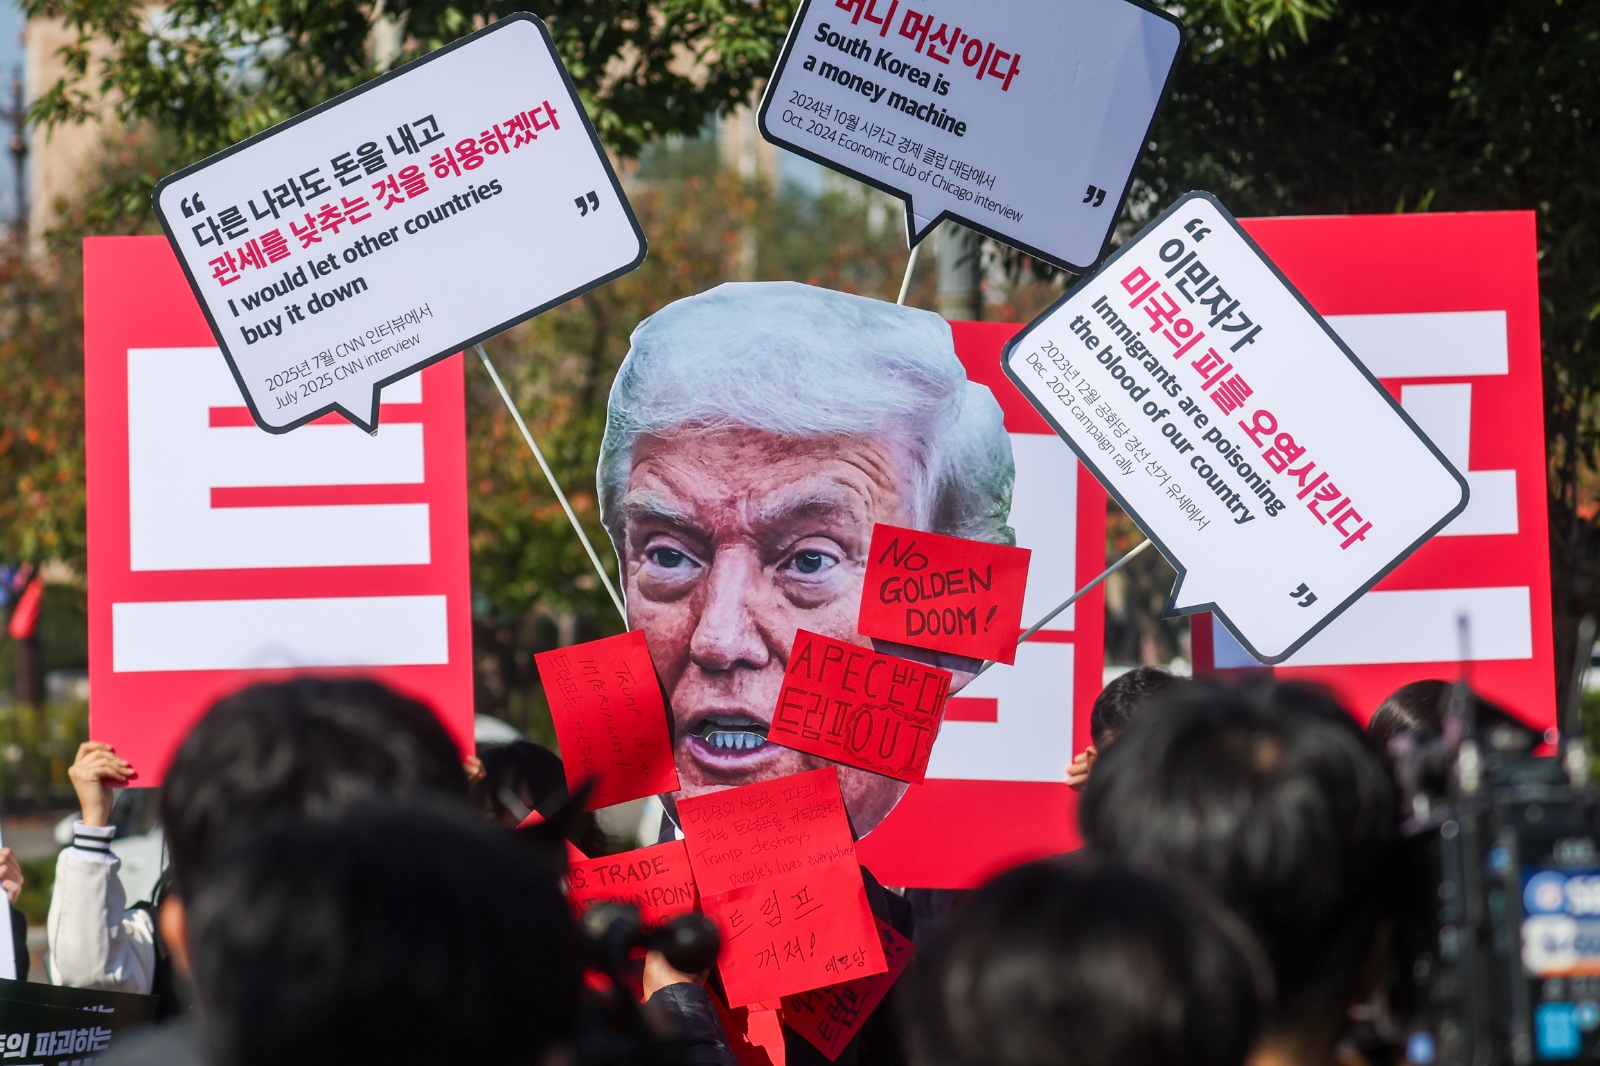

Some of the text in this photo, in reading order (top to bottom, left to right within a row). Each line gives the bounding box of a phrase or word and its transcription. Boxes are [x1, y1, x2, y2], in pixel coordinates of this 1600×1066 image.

[803, 55, 966, 137] a money machine
[814, 23, 950, 96] South Korea is
[783, 110, 1023, 222] Oct. 2024 Economic Club of Chicago interview
[789, 91, 996, 190] 2024년 10월 시카고 경제 클럽 대담에서
[192, 114, 445, 247] 다른 나라도 돈을 내고
[208, 100, 560, 287] 관세를 낮추는 것을 허용하겠다
[227, 179, 502, 317] I would let other countries
[240, 277, 368, 345] buy it down
[1159, 239, 1263, 353] 이민자가
[265, 303, 433, 391] 2025년 7월 CNN 인터뷰에서
[276, 334, 419, 409] July 2025 CNN interview
[1026, 352, 1134, 475] Dec. 2023 campaign rally
[1041, 340, 1210, 531] 2023년 12월 공화당 경선 선거 유세에서
[1070, 315, 1255, 524] the blood of our country
[1092, 295, 1286, 517] Immigrants are poisoning
[1120, 266, 1373, 550] 미국의 피를 오염시킨다
[878, 537, 930, 572] NO
[879, 565, 993, 605] GOLDEN
[549, 654, 582, 712] 트럼프는
[615, 661, 643, 717] TRUMP
[687, 802, 735, 823] 민중의
[740, 791, 775, 813] 삶을
[698, 828, 729, 844] 하는
[733, 811, 786, 835] 트럼프를
[592, 855, 669, 887] TRADE
[696, 831, 810, 868] Trump destroys
[728, 862, 773, 887] people's
[776, 859, 801, 874] lives
[754, 931, 816, 971] 꺼져!
[33, 1026, 112, 1056] 파괴하는
